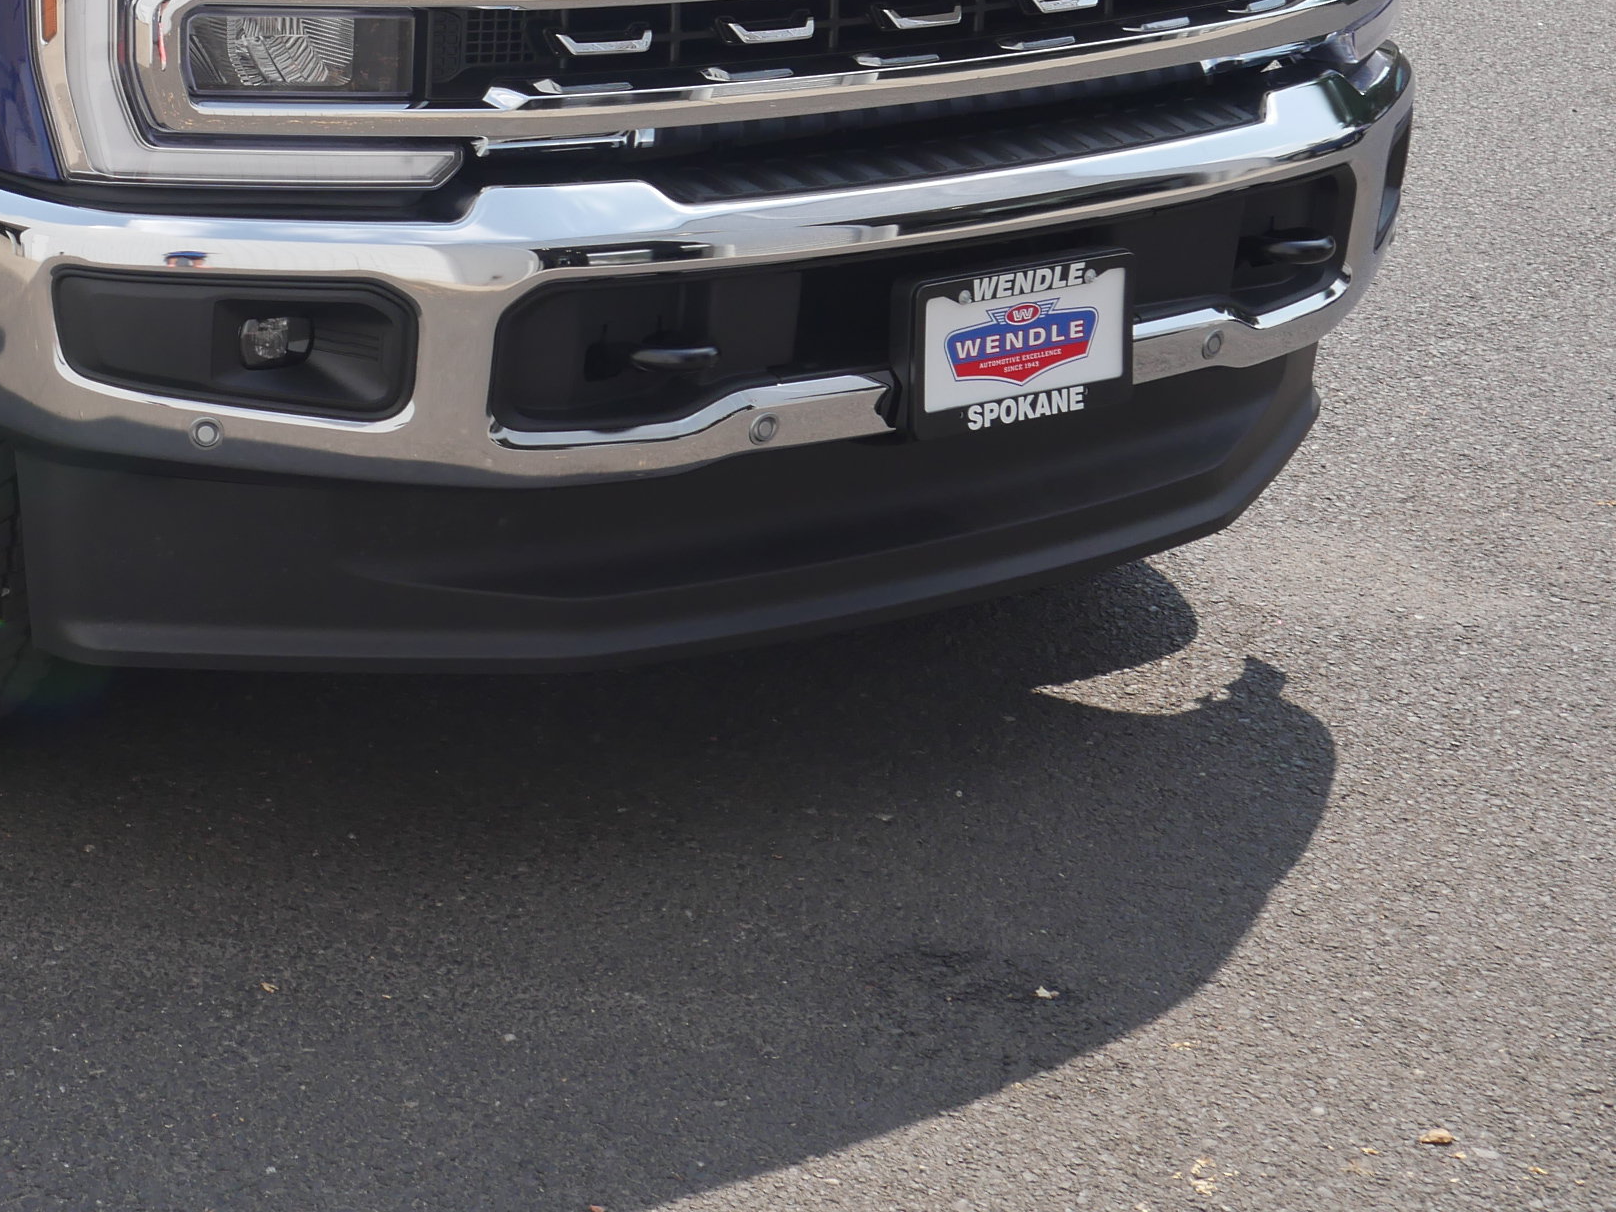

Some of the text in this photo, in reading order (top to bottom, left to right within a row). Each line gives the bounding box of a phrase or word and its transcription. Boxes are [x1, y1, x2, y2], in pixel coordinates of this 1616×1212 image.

[973, 262, 1086, 302] WENDLE
[955, 320, 1085, 359] WENDLE
[979, 348, 1062, 369] AUTOMOTIVE EXCELLENCE
[1003, 361, 1040, 373] SINCE 1943
[967, 386, 1085, 431] SPOKANE
